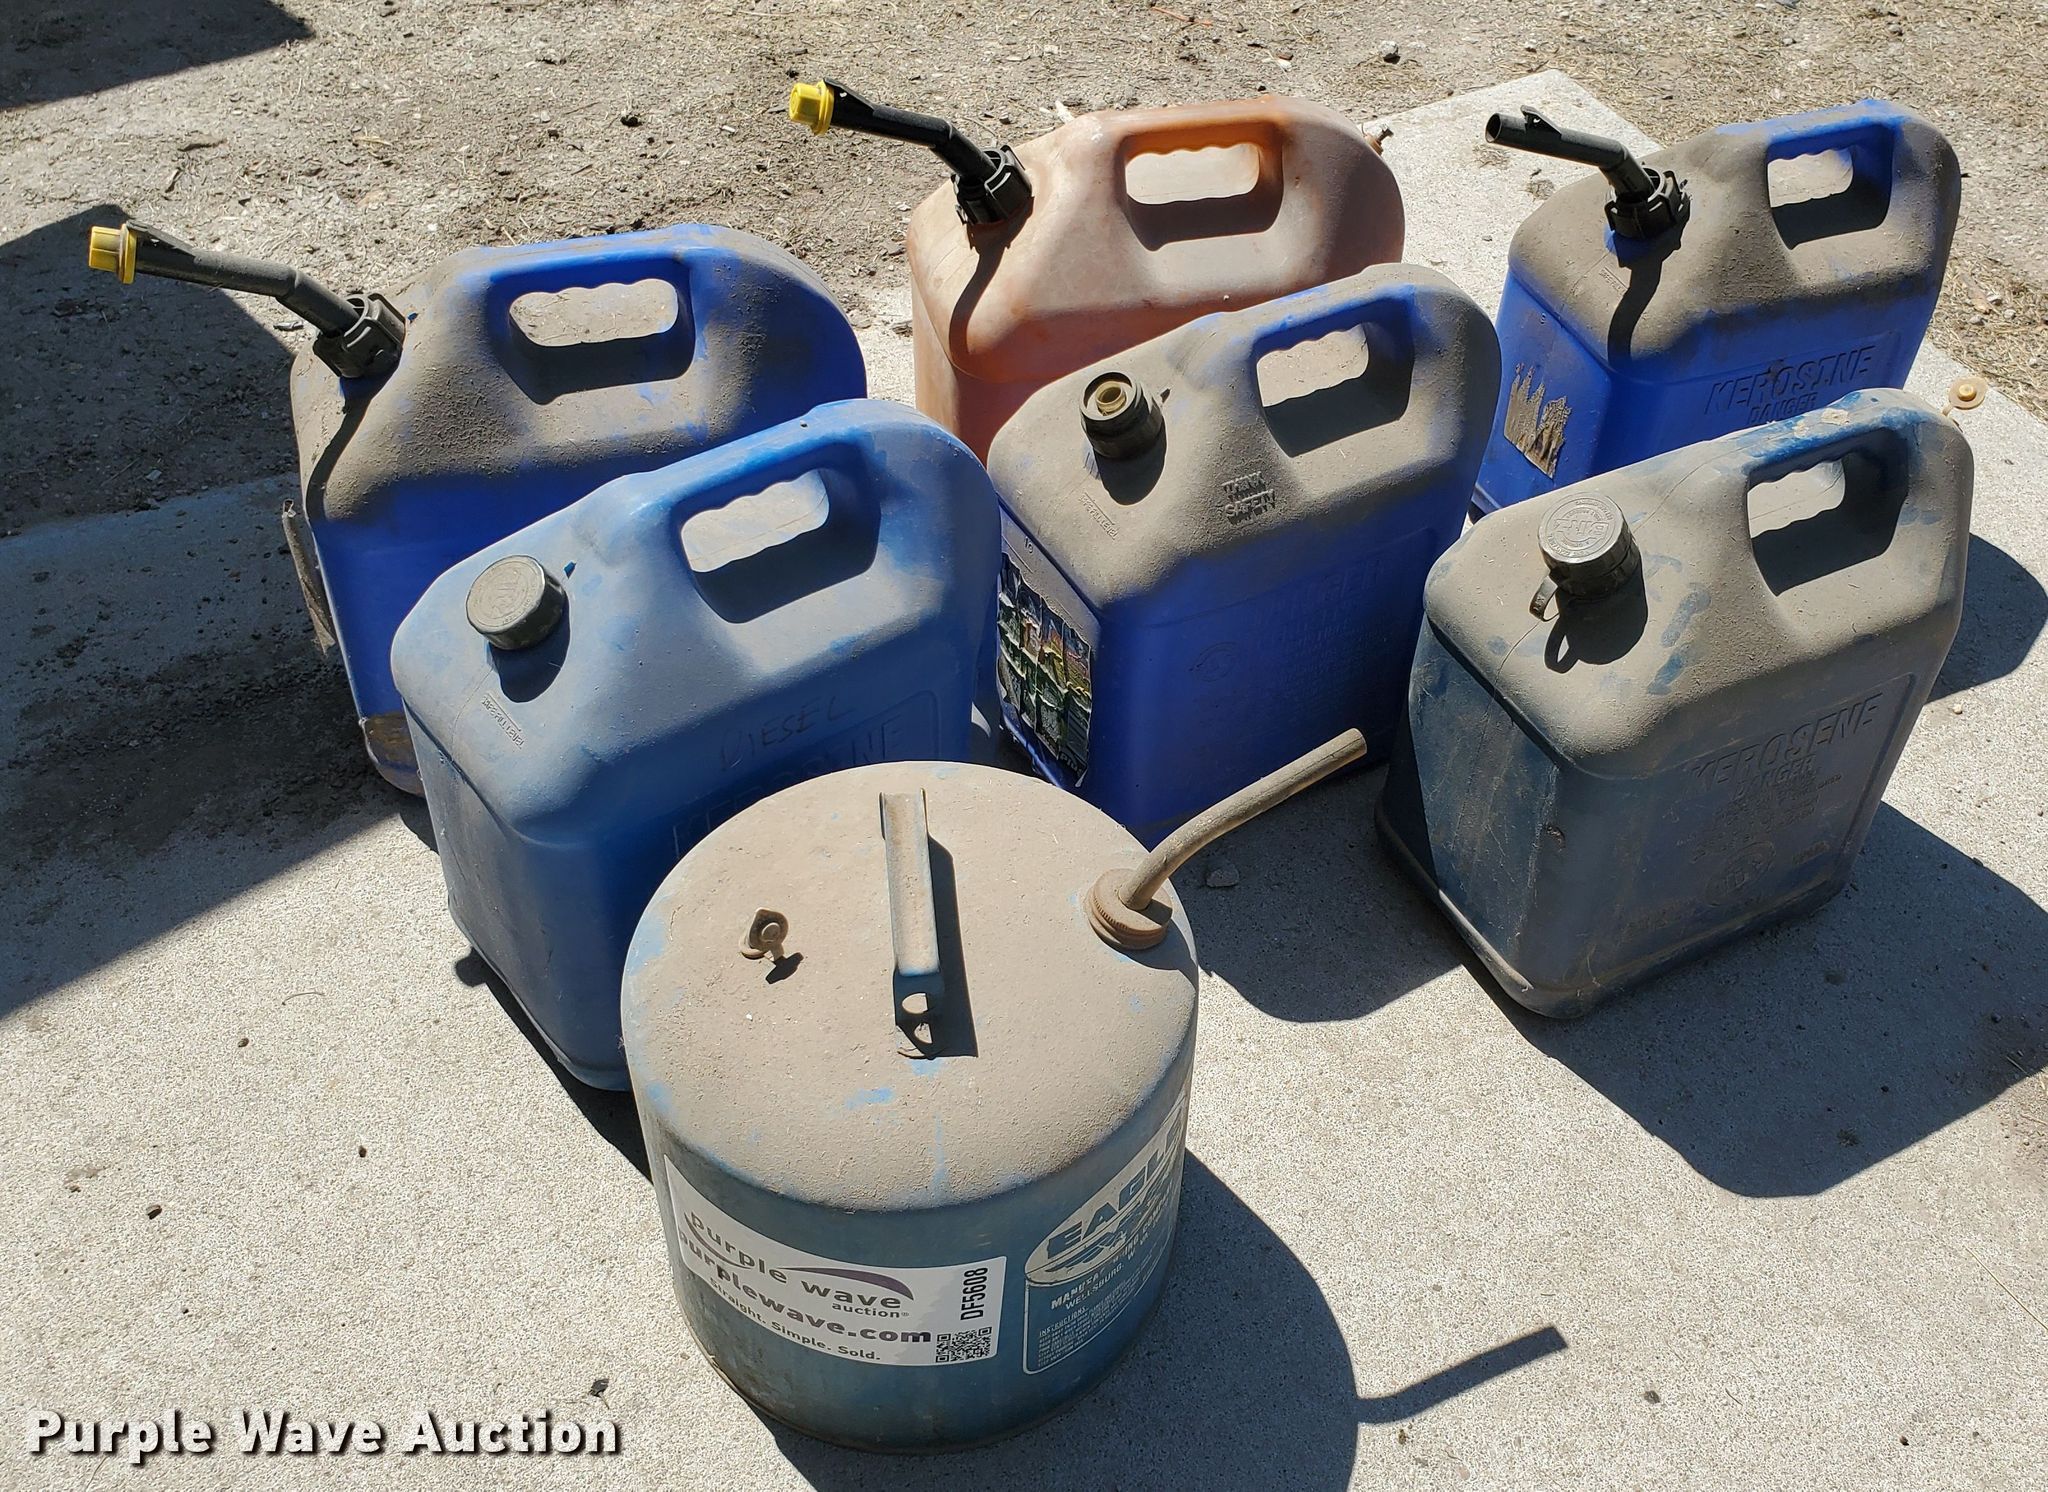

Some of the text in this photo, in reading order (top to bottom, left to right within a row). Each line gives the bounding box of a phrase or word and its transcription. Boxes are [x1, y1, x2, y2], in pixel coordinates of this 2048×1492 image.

[720, 694, 857, 771] DIESEL
[1690, 692, 1884, 791] KEROSENE
[678, 1225, 932, 1343] purplewave.com
[691, 1212, 901, 1309] purple wave
[960, 1267, 988, 1321] DF5608
[771, 1321, 832, 1351] Simple.
[838, 1345, 881, 1361] Sold.
